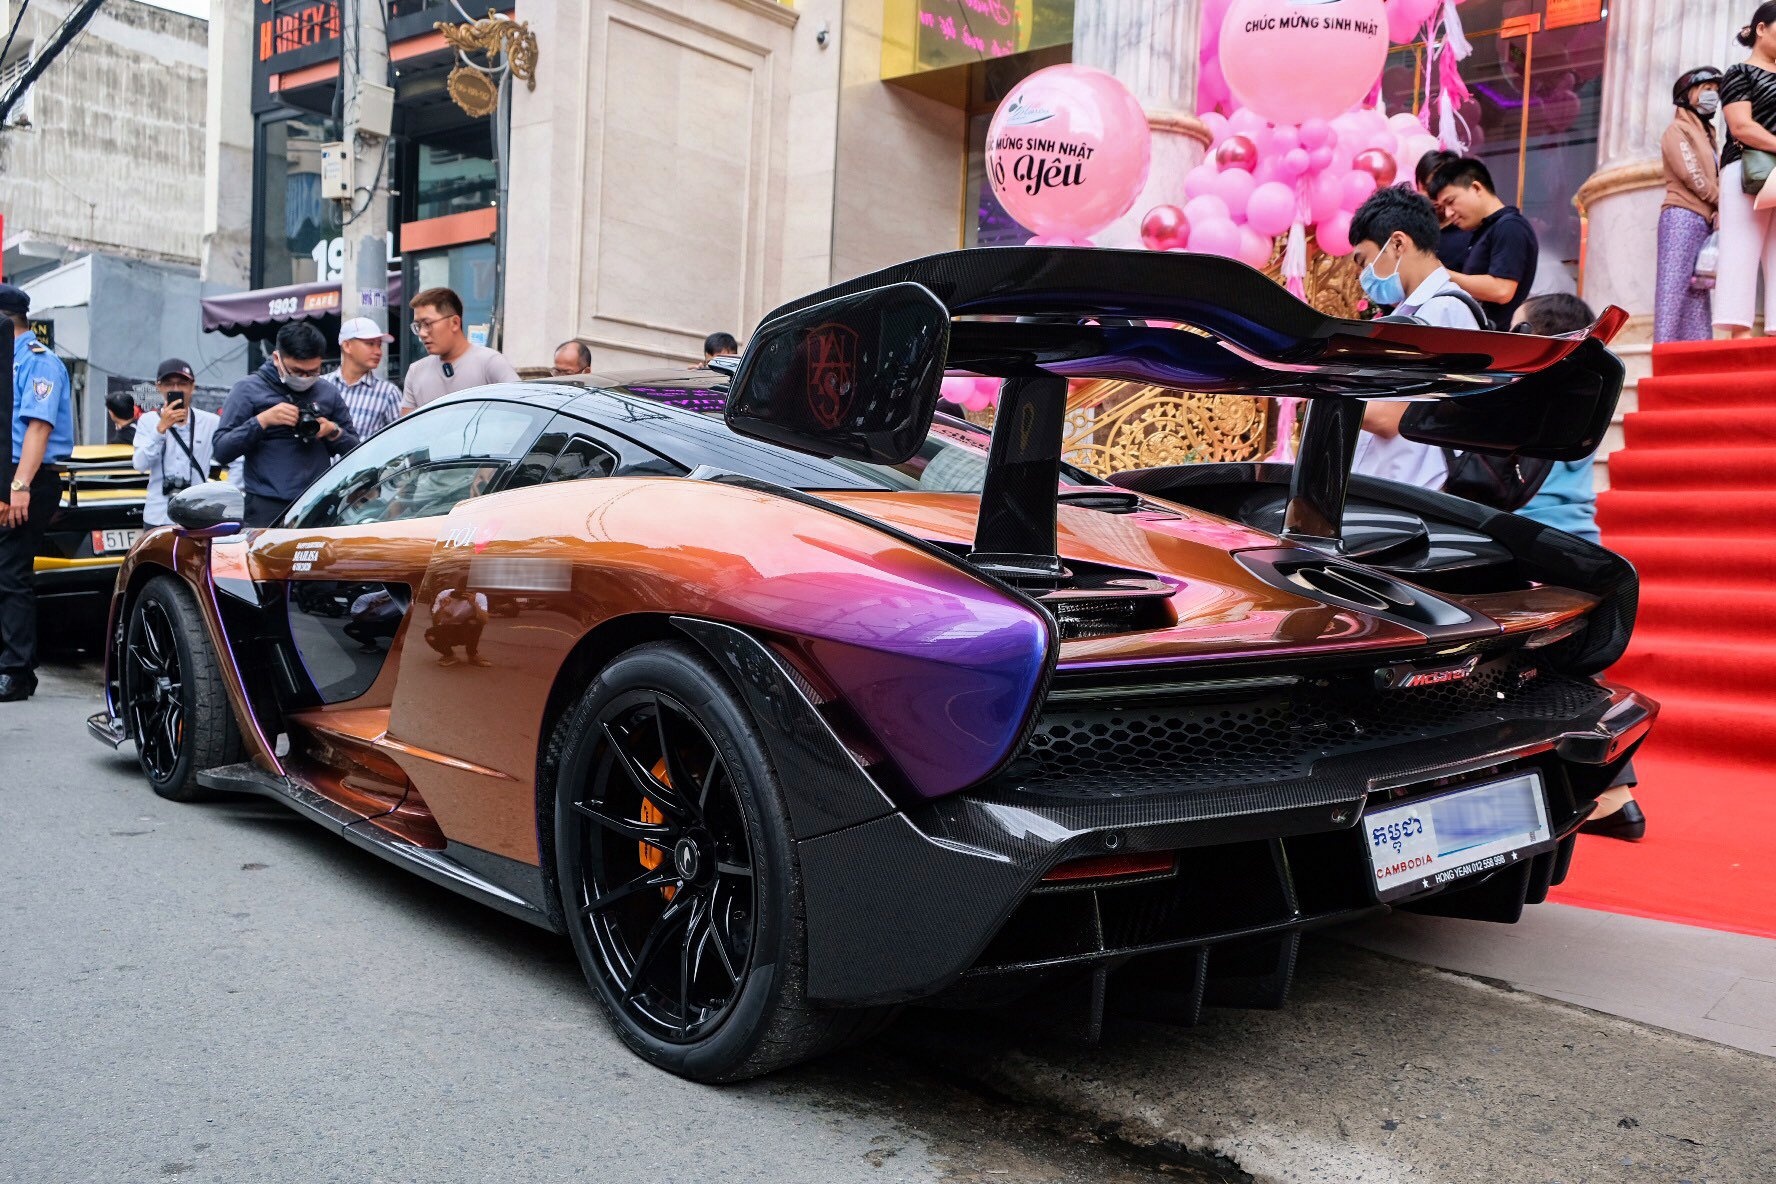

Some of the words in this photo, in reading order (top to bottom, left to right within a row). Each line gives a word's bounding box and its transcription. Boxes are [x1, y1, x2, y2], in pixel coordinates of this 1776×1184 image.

[1245, 14, 1275, 32] CHÚC
[1323, 17, 1351, 30] SINH
[1026, 138, 1056, 153] SINH
[268, 296, 299, 316] 1903
[1406, 667, 1470, 688] McLaren
[1376, 854, 1433, 879] CAMBODIA
[1434, 870, 1455, 884] HONG
[1454, 864, 1472, 878] YEAN
[1471, 860, 1483, 872] 012
